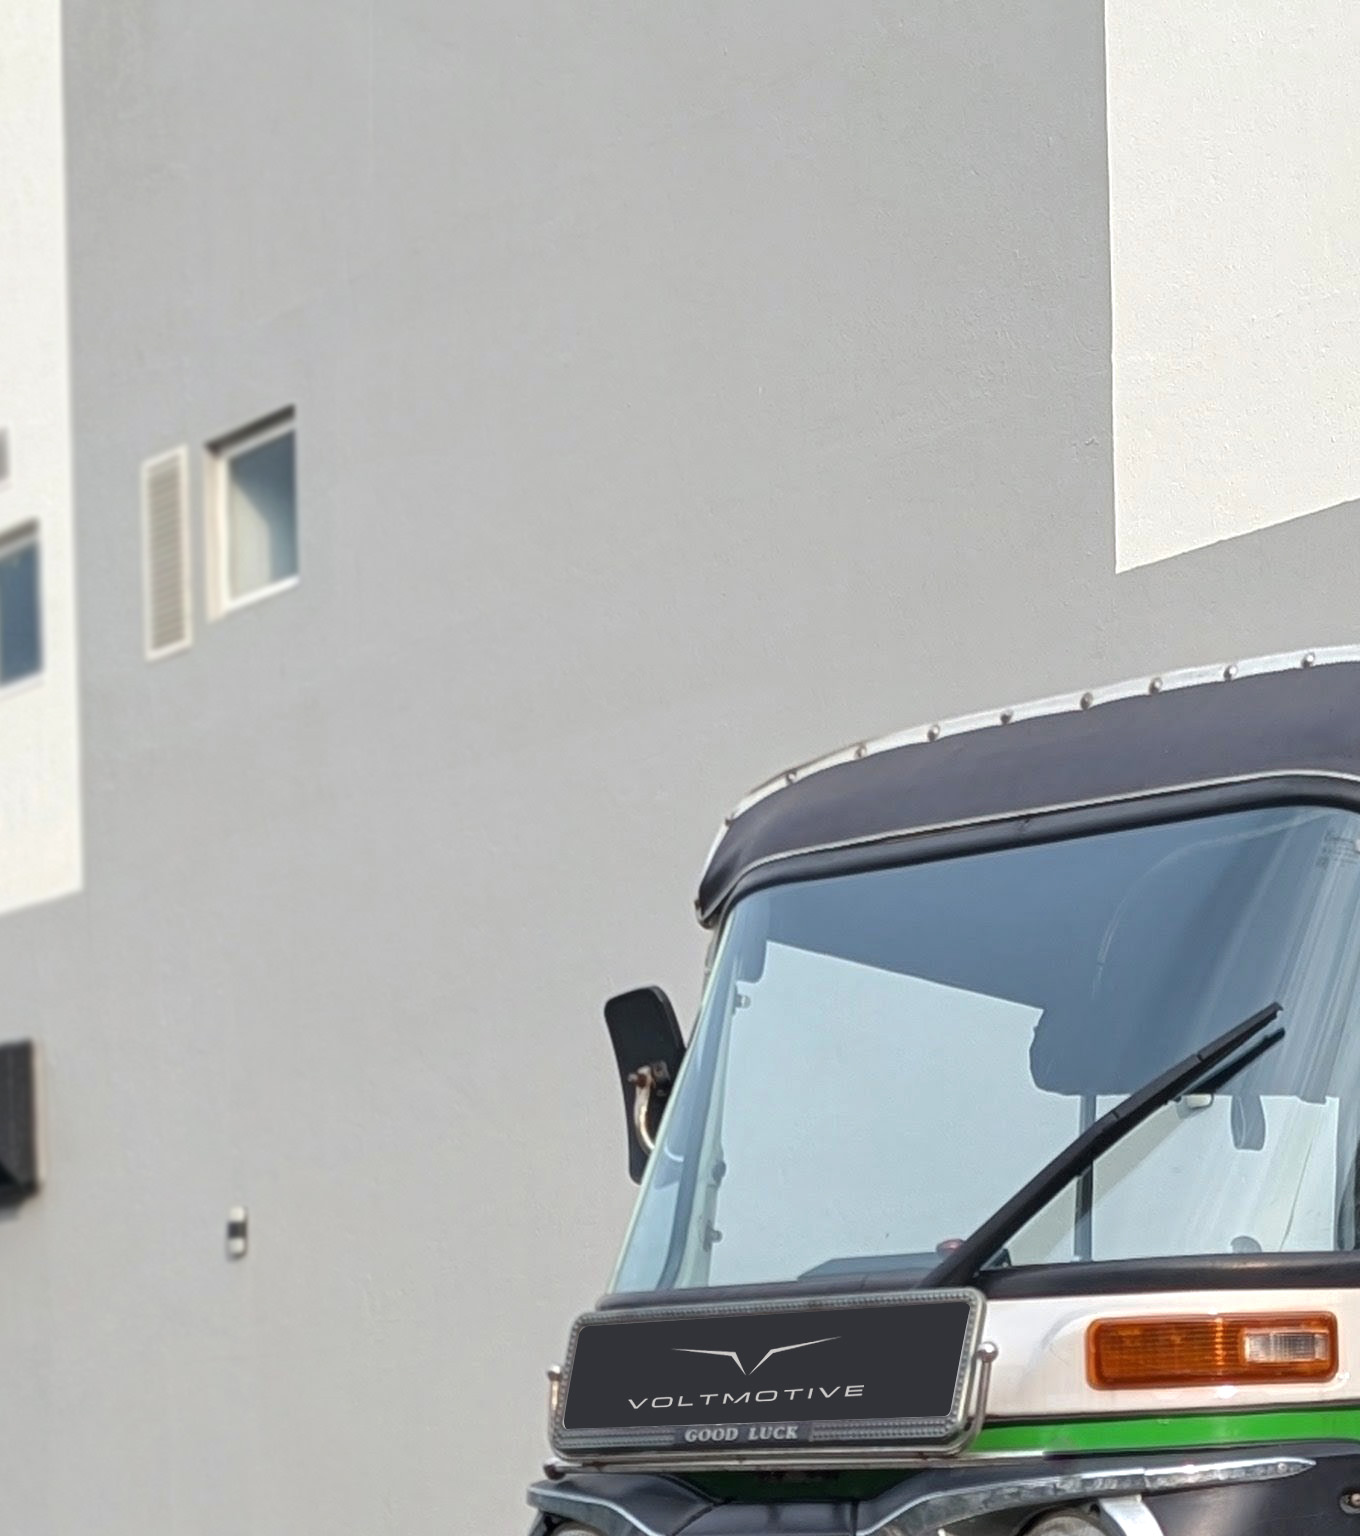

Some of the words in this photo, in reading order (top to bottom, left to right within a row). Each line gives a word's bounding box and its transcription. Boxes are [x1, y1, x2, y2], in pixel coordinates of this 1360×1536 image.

[628, 1384, 865, 1410] VOLTMOTIVE
[684, 1427, 739, 1443] GOOD
[748, 1425, 799, 1441] LUCK
